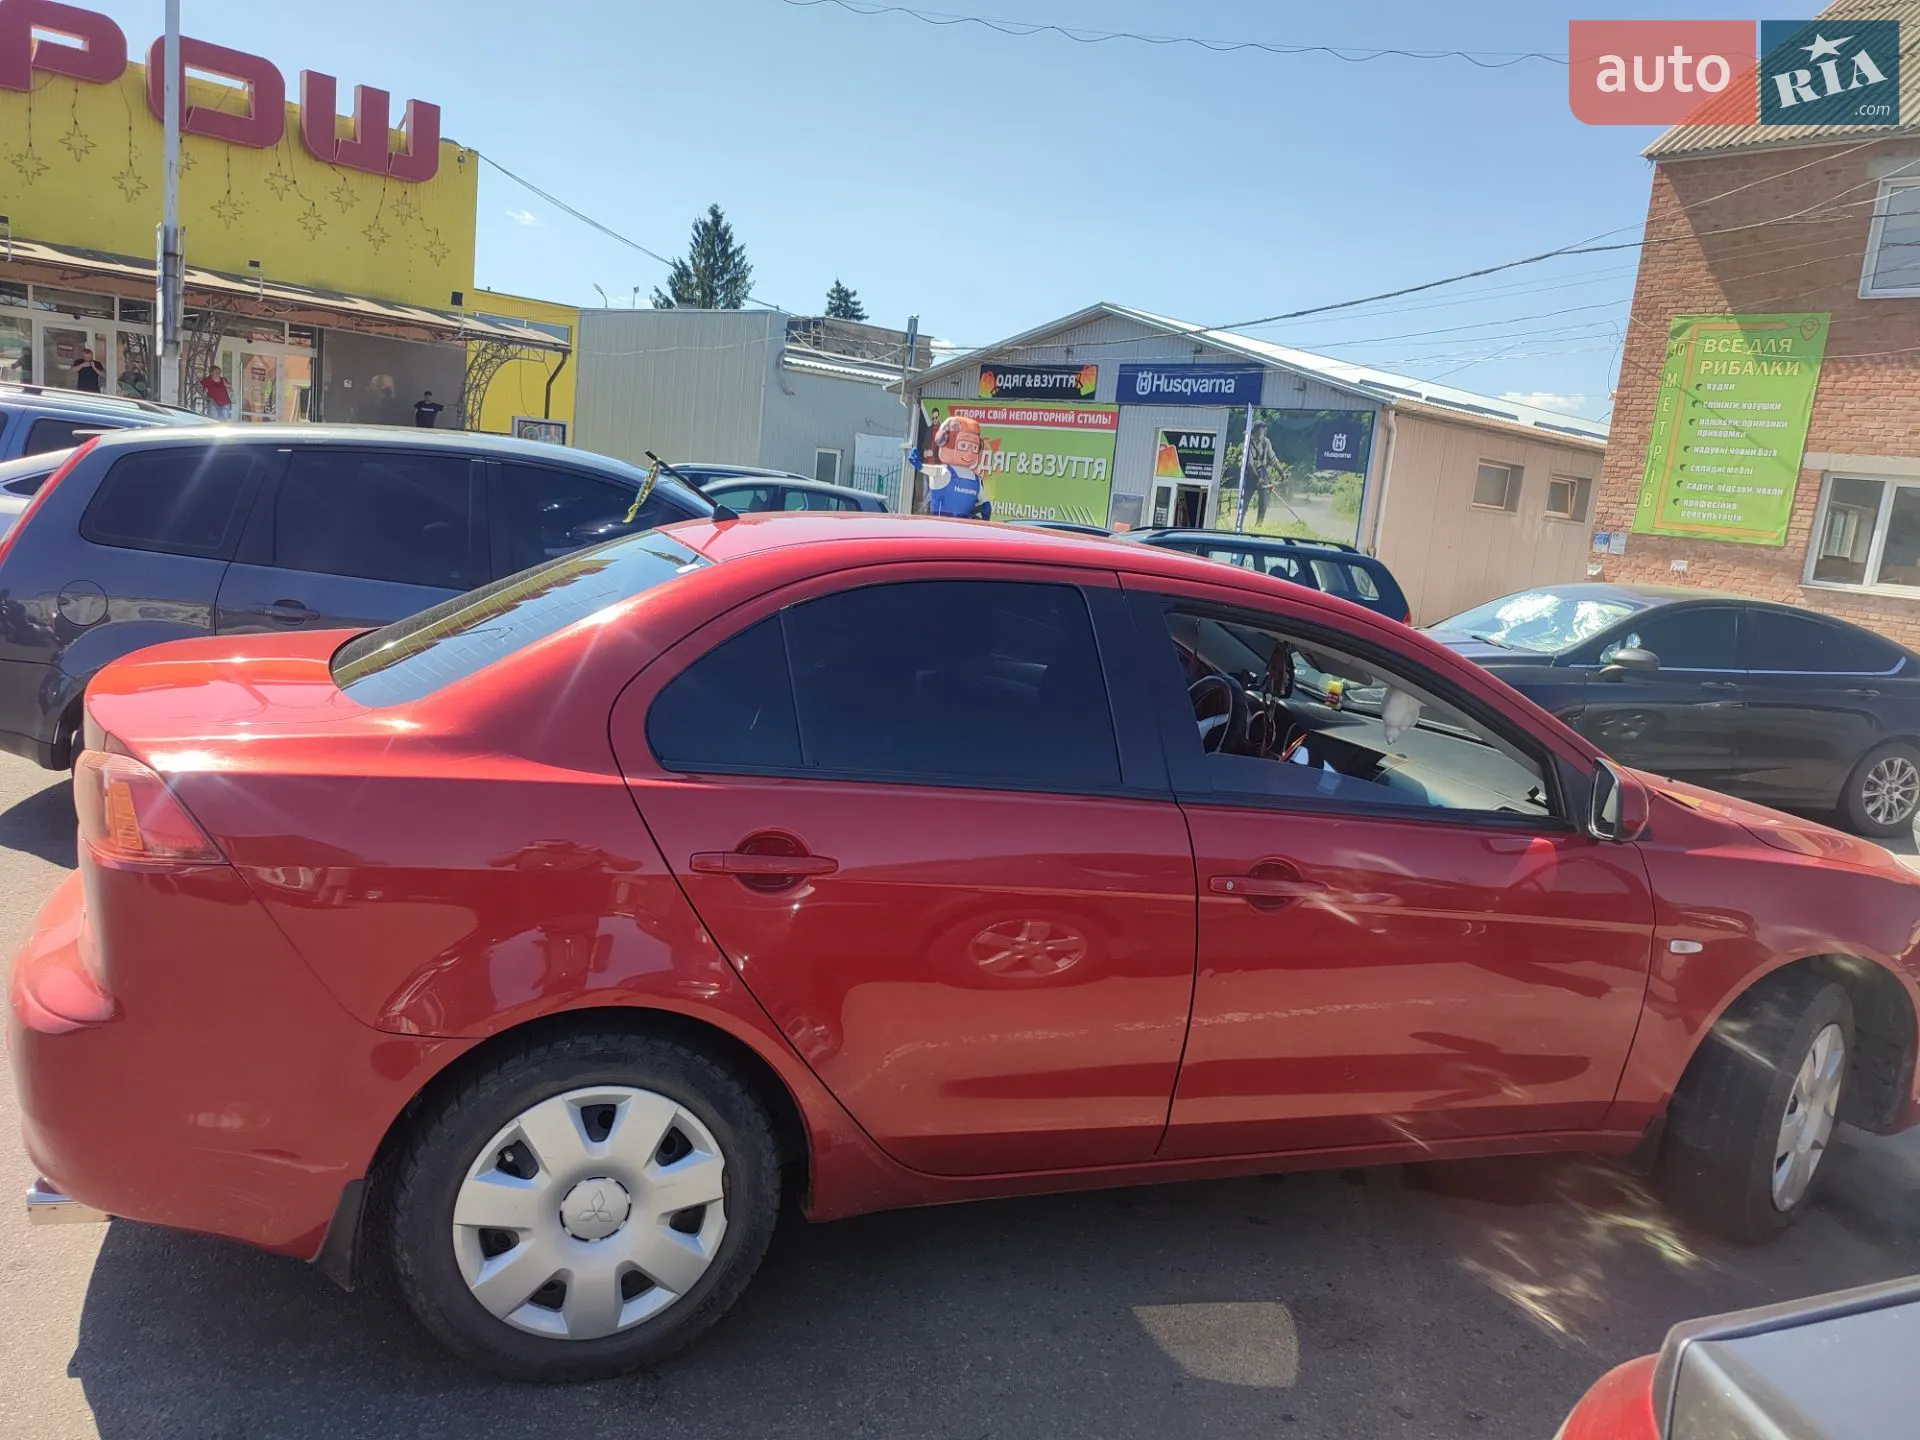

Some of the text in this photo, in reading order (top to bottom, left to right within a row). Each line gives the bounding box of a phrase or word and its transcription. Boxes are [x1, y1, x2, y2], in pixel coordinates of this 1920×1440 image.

[1704, 338, 1793, 355] ВСЕ ДЛЯ
[1700, 360, 1801, 376] РИБАЛКИ
[996, 374, 1076, 388] ОДЯГ&ВЗУТТЯ
[1152, 373, 1235, 396] Husqvarna
[954, 408, 1112, 425] СТВОРИ СВІЙ НЕПОВТОРНИЙ СТИЛЬ!
[972, 449, 1107, 481] ДЯГ&ВЗУТТЯ
[991, 501, 1056, 520] УНІКАЛЬНО
